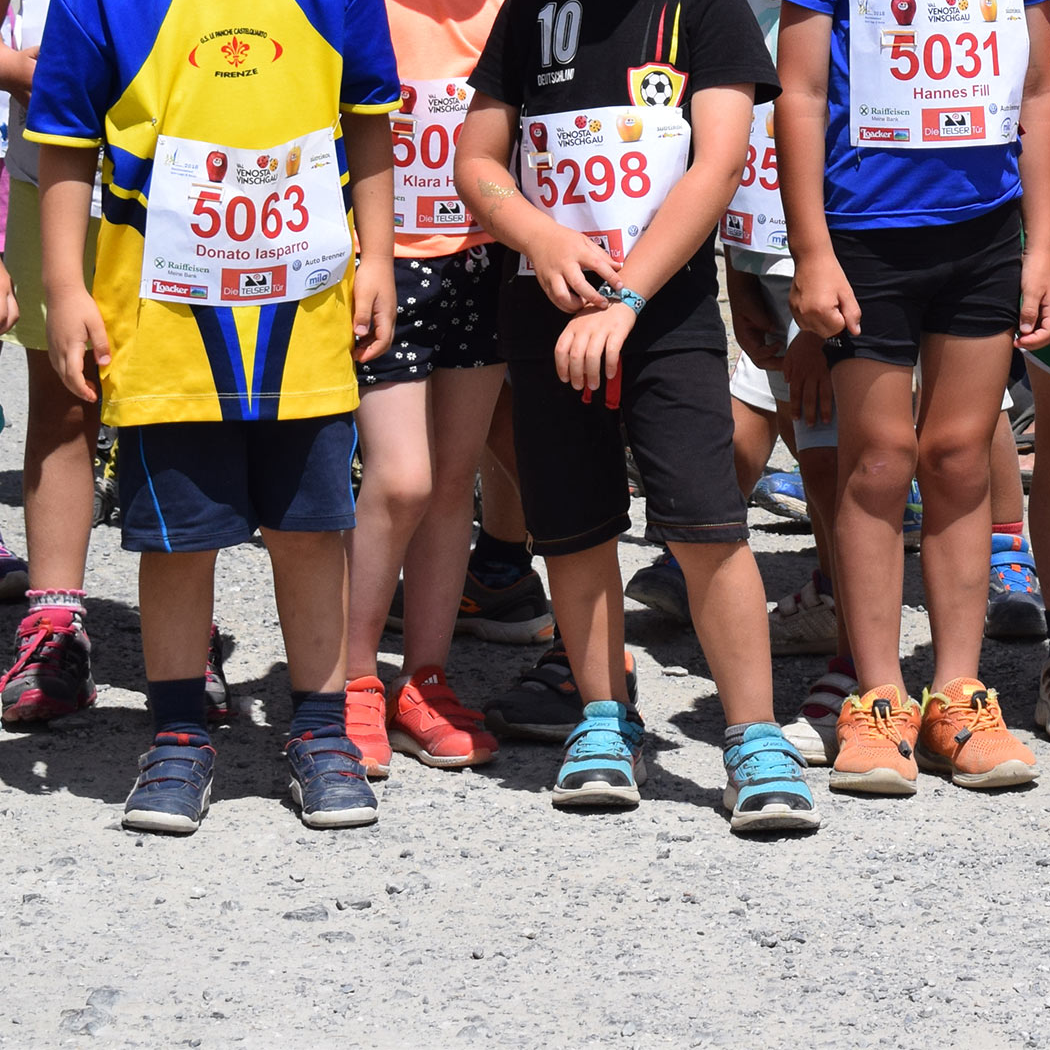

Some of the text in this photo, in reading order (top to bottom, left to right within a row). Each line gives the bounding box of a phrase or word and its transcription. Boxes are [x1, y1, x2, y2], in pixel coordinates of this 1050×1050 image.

[928, 7, 961, 15] VENOSTA
[928, 13, 970, 23] VINSCHGAU
[537, 0, 583, 68] 10
[890, 30, 1000, 81] 5031
[214, 68, 258, 78] FIRENZE
[913, 85, 990, 100] Hannes Fill
[428, 97, 460, 107] VENOSTA
[428, 103, 469, 114] VINSCHGAU
[871, 107, 910, 116] Raiffeisen
[556, 130, 592, 139] VENOSTA
[860, 128, 892, 139] Loacker
[924, 125, 983, 136] Die TELSER Tür
[557, 135, 604, 147] VINSCHGAU
[236, 168, 271, 177] VENOSTA
[236, 174, 279, 185] VINSCHGAU
[403, 175, 441, 188] Klara
[536, 151, 651, 208] 5298
[190, 185, 310, 242] 5063
[418, 214, 434, 223] Die
[435, 215, 464, 223] TELSER
[196, 244, 250, 260] Donato
[304, 251, 346, 267] Auto Brenner
[167, 261, 210, 274] Raiffeisen
[309, 273, 329, 284] mila
[153, 280, 189, 295] Loacker
[223, 284, 285, 296] Die TELSER Tür
